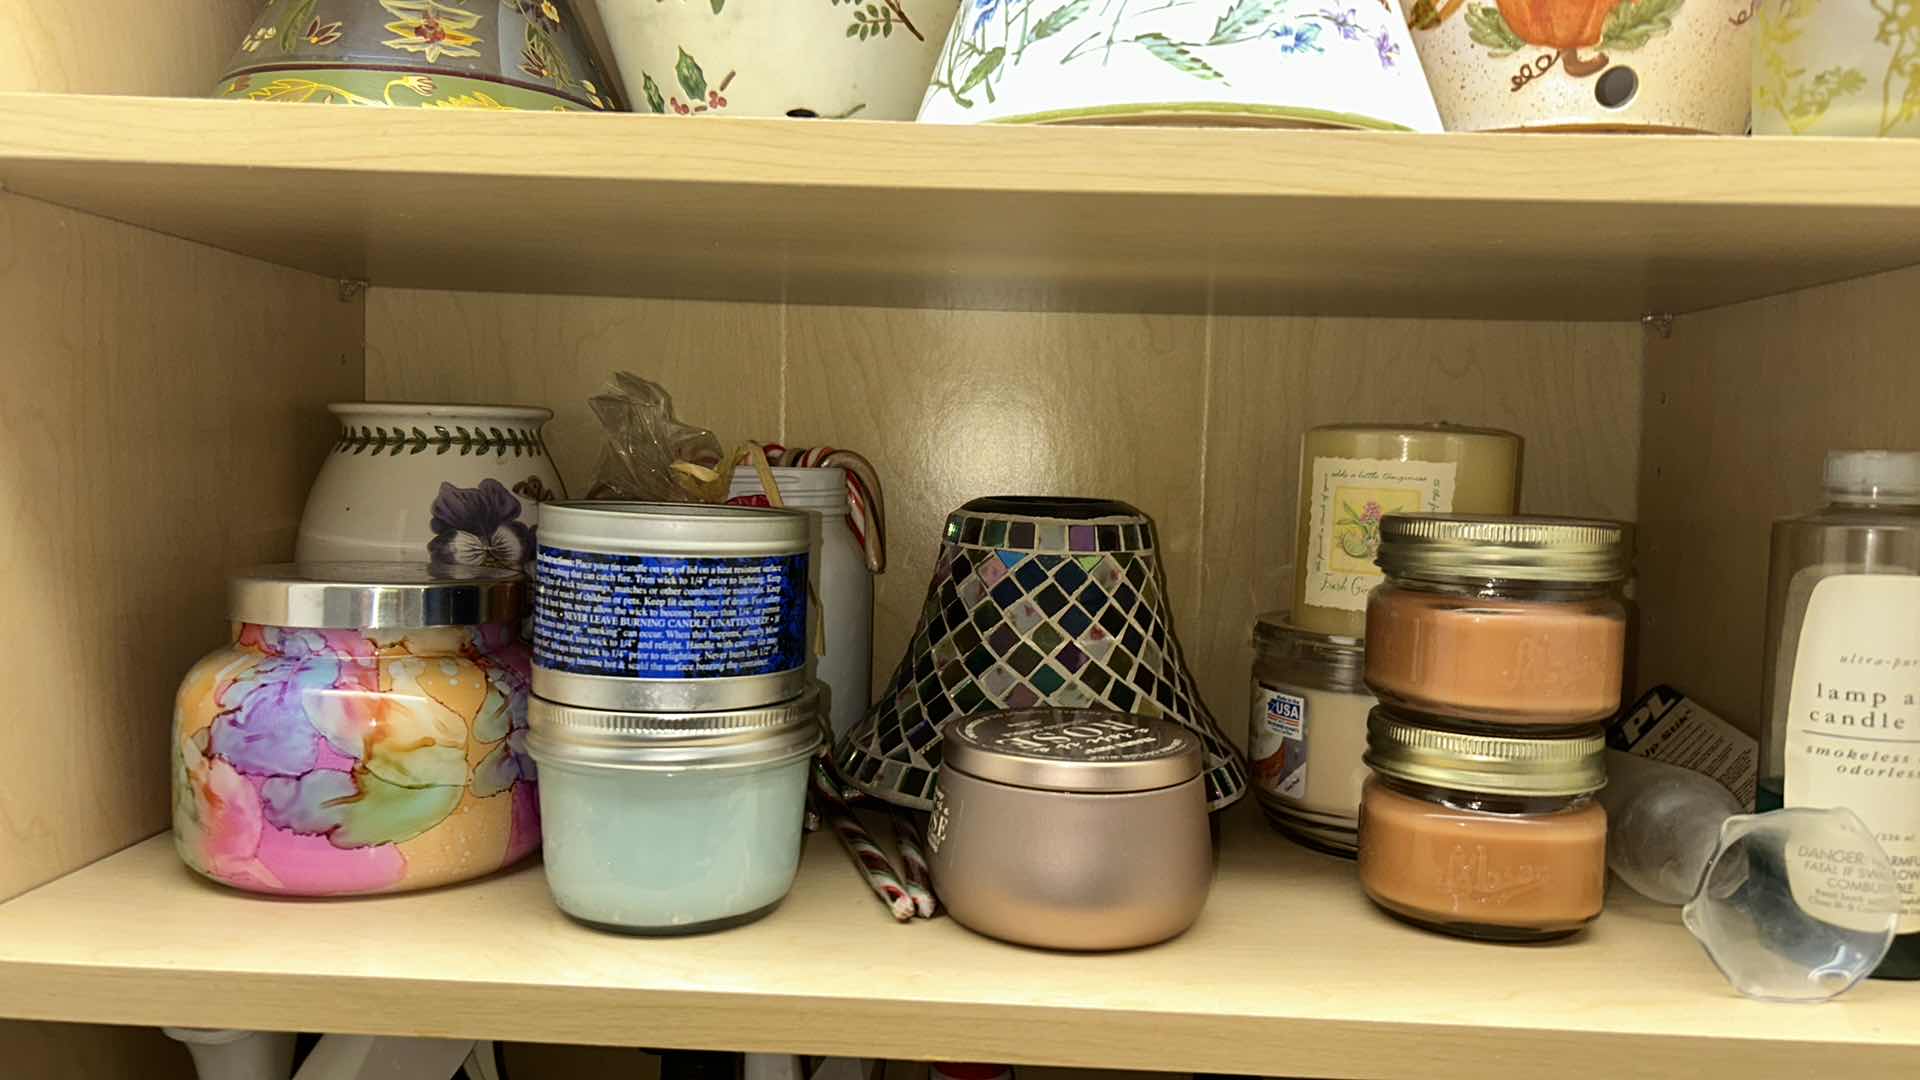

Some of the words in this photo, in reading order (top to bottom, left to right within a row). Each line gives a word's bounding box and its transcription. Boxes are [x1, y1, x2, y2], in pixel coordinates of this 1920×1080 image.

[592, 563, 609, 572] your
[622, 564, 647, 573] candle
[661, 565, 675, 575] top
[675, 565, 686, 573] of
[596, 573, 616, 581] catch
[635, 574, 656, 584] Trim
[656, 575, 678, 584] wick
[708, 577, 727, 587] prior
[615, 586, 647, 594] matches
[659, 587, 682, 595] other
[643, 596, 666, 608] Keep
[678, 598, 706, 606] candle
[614, 606, 627, 615] the
[628, 607, 648, 616] wick
[649, 608, 658, 616] to
[660, 608, 692, 617] become
[564, 611, 589, 622] NEVER
[590, 615, 618, 625] LEAVE
[620, 617, 665, 627] BURNING
[667, 618, 708, 628] CANDLE
[639, 631, 664, 639] occur.
[666, 630, 690, 639] When
[637, 640, 653, 649] and
[685, 640, 715, 649] Handle
[628, 652, 649, 661] prior
[650, 652, 660, 660] to
[704, 650, 727, 660] Never
[1840, 653, 1920, 670] ultra-pur
[650, 662, 662, 670] the
[664, 662, 694, 671] surface
[1816, 682, 1887, 708] lamp
[1276, 702, 1299, 719] USA
[1809, 710, 1905, 730] candle
[1806, 744, 1910, 763] smokeless
